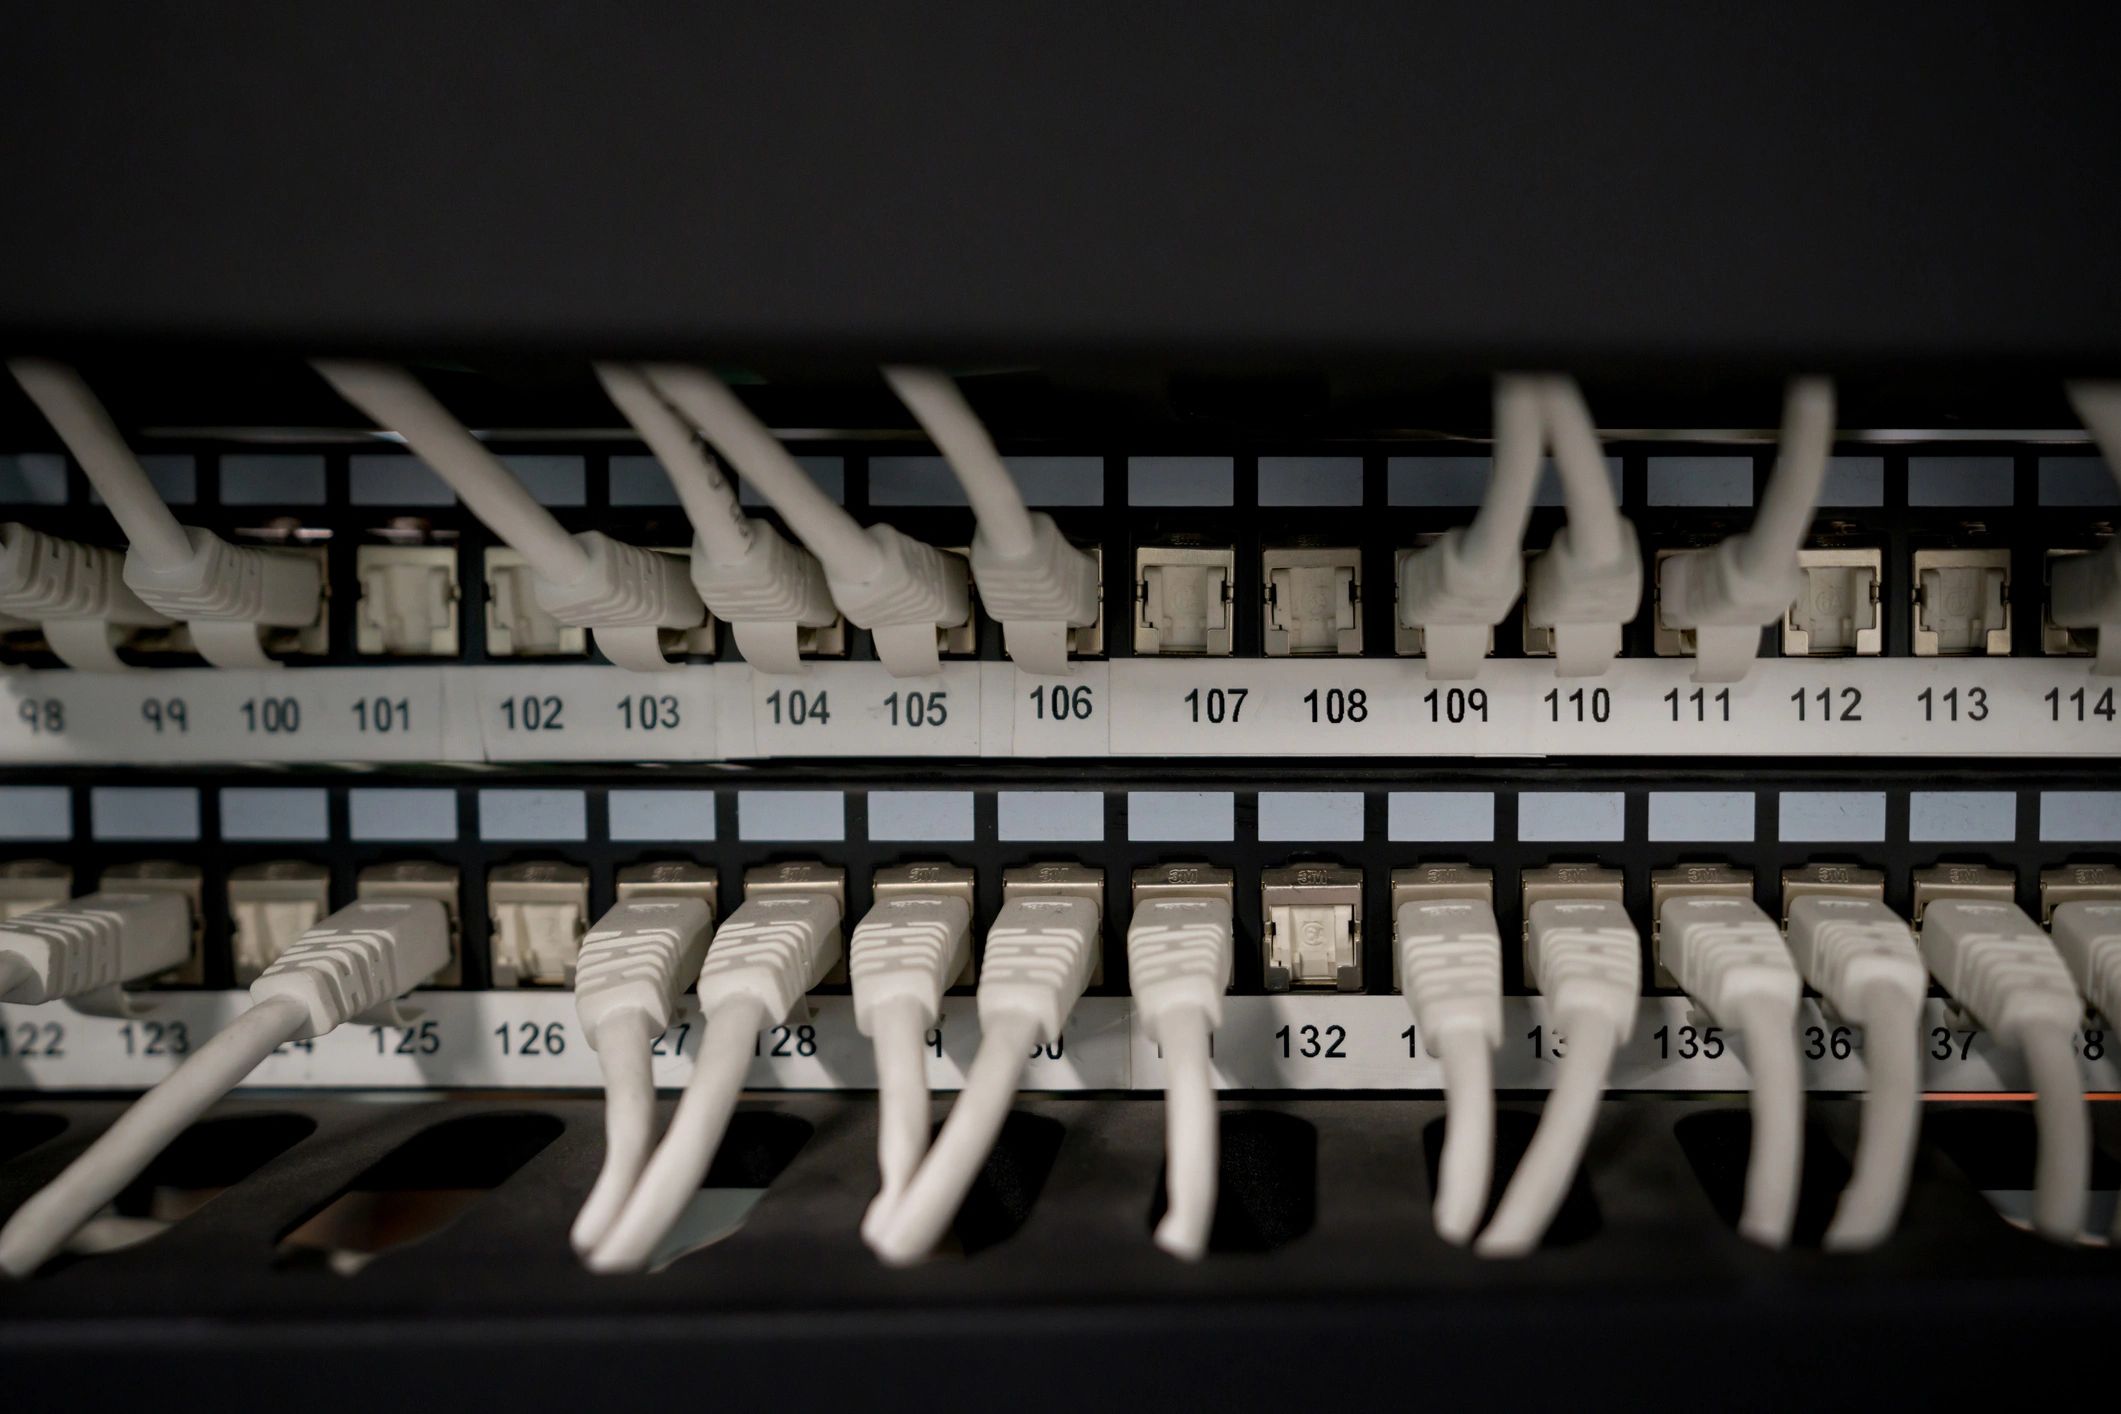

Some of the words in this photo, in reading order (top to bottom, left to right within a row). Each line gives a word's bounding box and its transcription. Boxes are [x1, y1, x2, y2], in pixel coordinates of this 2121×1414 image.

[18, 699, 65, 732] 98
[142, 699, 188, 732] 99
[241, 698, 300, 733] 100
[352, 697, 408, 732] 101
[501, 696, 563, 730] 102
[618, 696, 680, 730] 103
[767, 690, 830, 725] 104
[884, 692, 947, 727] 105
[1031, 686, 1092, 720] 106
[1185, 689, 1248, 723] 107
[1304, 689, 1367, 723] 108
[1424, 689, 1487, 723] 109
[1545, 688, 1610, 722] 110
[1665, 688, 1729, 721] 111
[1791, 687, 1861, 721] 112
[1918, 687, 1988, 721] 113
[2045, 687, 2116, 721] 114
[1168, 869, 1198, 884] 3M
[1297, 869, 1328, 885] 3M
[1688, 868, 1719, 883] 3M
[1818, 867, 1848, 883] 3M
[119, 1020, 190, 1056] 123
[370, 1021, 440, 1054] 125
[496, 1022, 565, 1055] 126
[1276, 1025, 1346, 1058] 132
[1654, 1026, 1724, 1059] 135
[1804, 1026, 1852, 1060] 36
[1931, 1026, 1978, 1060] 37
